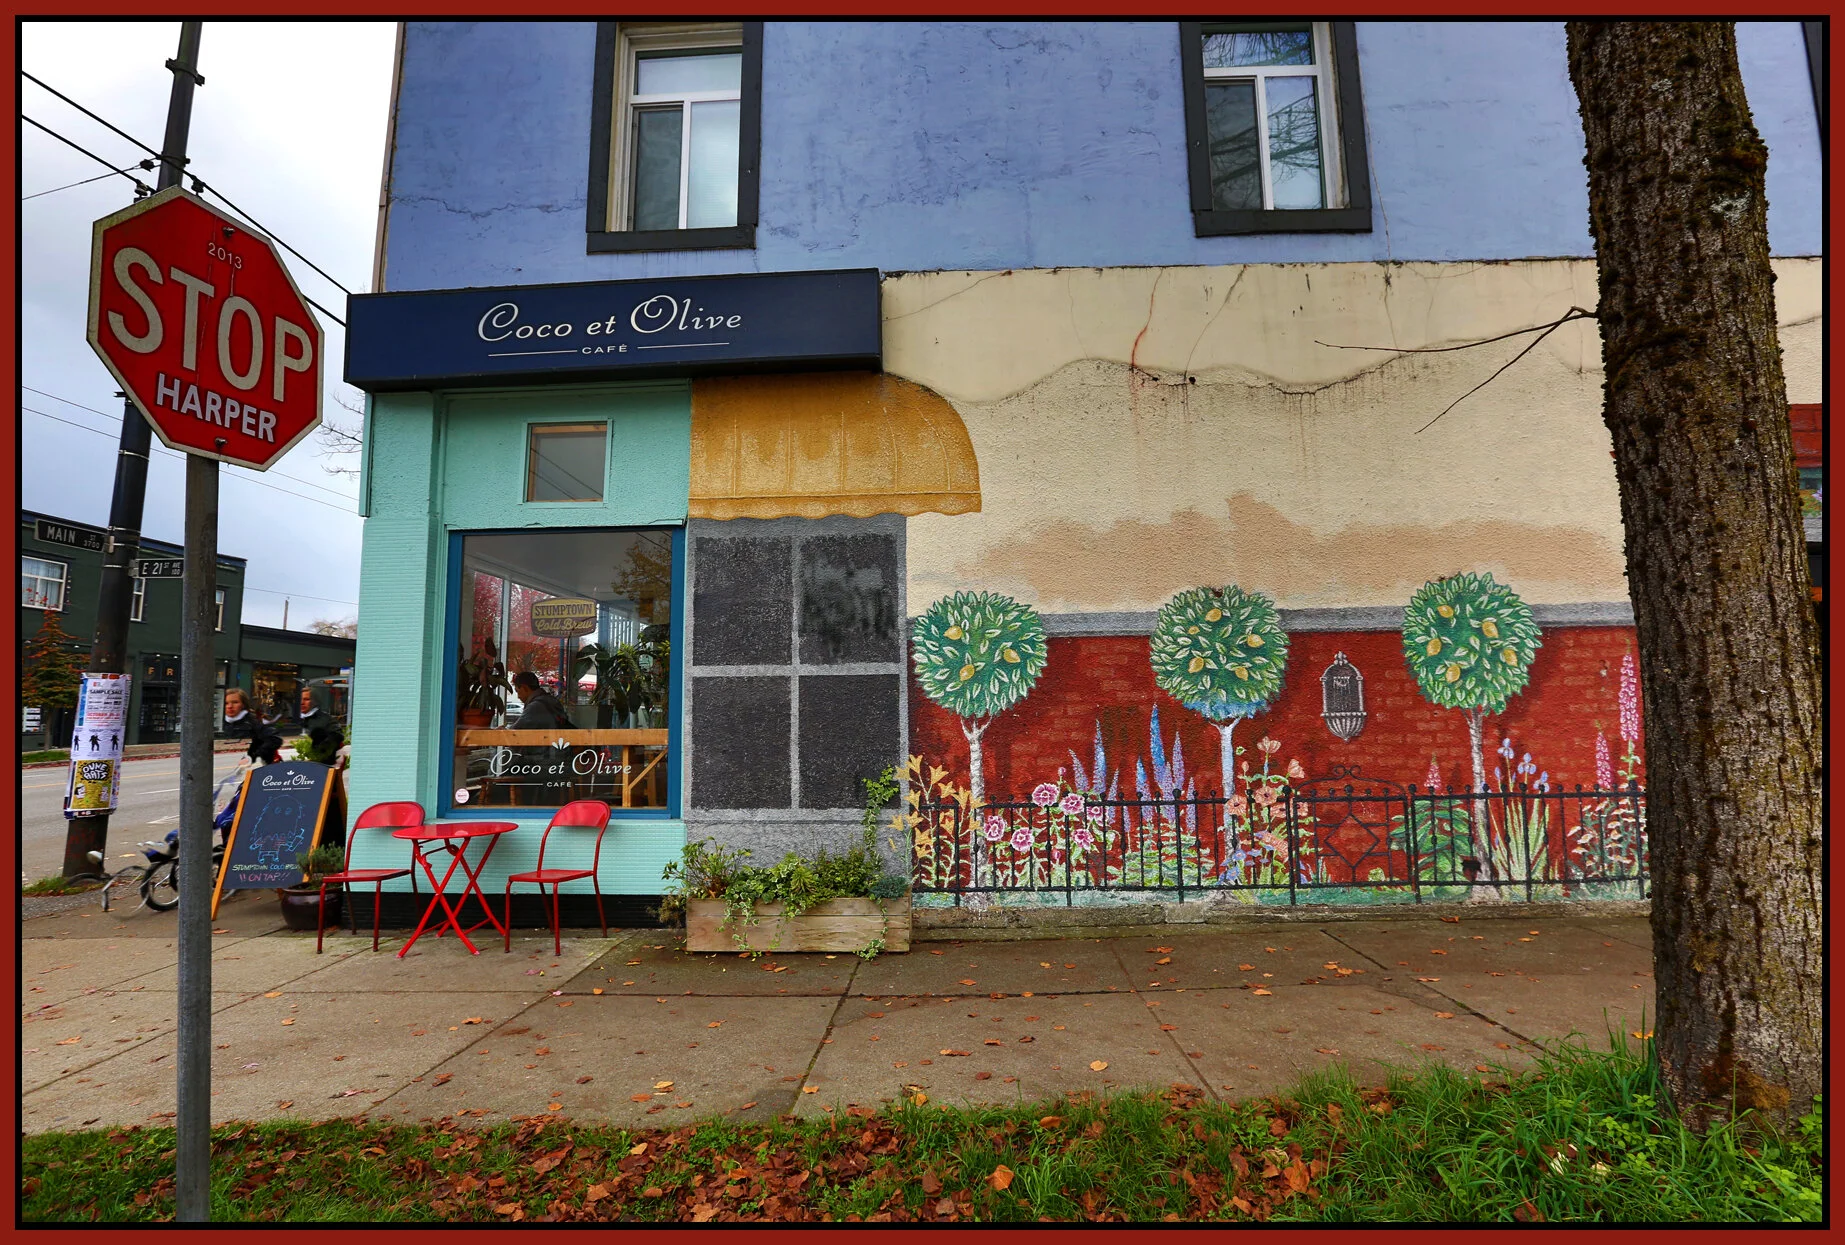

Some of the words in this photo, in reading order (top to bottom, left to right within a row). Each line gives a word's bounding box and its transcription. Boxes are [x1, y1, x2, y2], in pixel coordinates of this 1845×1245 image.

[208, 242, 243, 270] 2013
[107, 247, 313, 402] STOP
[478, 302, 573, 342] Coco
[586, 315, 616, 335] et
[630, 294, 742, 334] Olive
[582, 344, 628, 355] CAFÉ
[156, 373, 277, 443] HARPER
[46, 525, 76, 544] MAIN
[89, 534, 97, 542] ST
[83, 540, 100, 549] 3700
[142, 562, 149, 575] E
[535, 603, 593, 616] STUMPTOWN
[535, 619, 561, 631] Cold
[562, 618, 593, 630] Brew
[490, 749, 541, 775] Coco
[548, 761, 565, 774] et
[572, 749, 632, 775] Olive
[262, 775, 282, 787] Coco
[292, 774, 315, 786] Olive
[231, 863, 268, 871] STUMPTOWN
[269, 863, 285, 871] COLD
